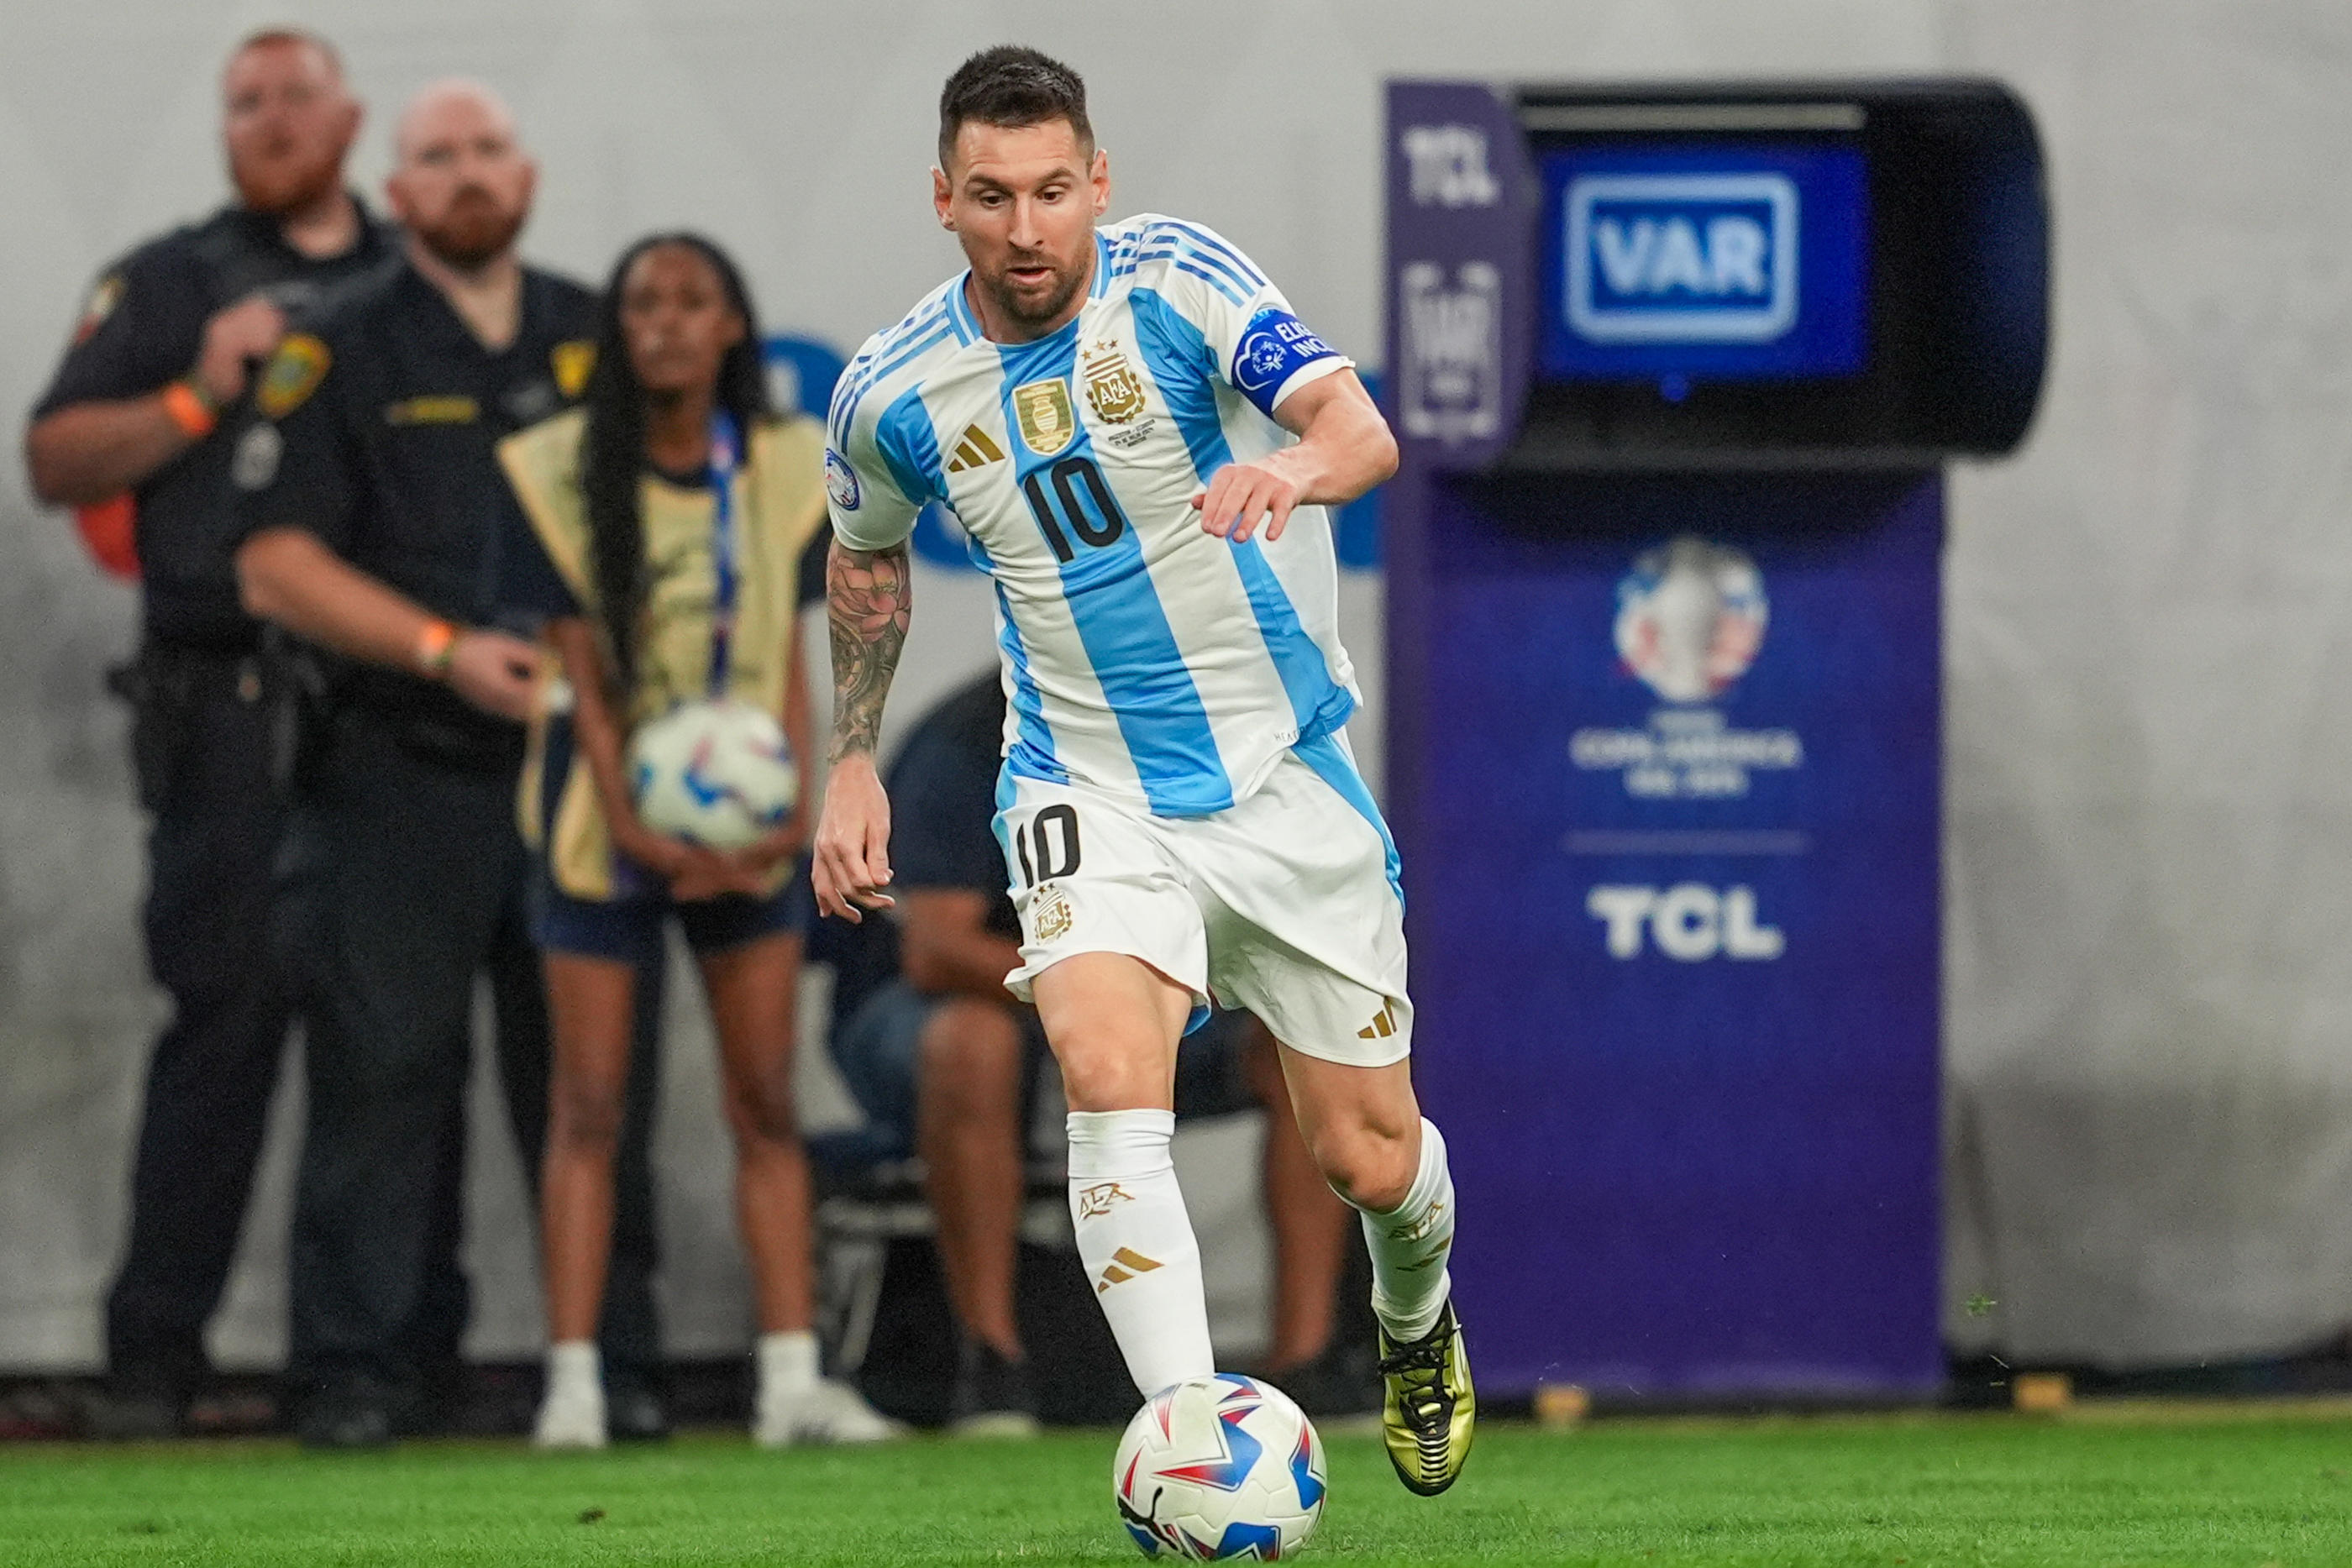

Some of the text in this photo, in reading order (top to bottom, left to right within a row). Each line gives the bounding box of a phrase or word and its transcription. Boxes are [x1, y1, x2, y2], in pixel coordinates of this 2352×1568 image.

[1598, 215, 1766, 294] VAR
[1097, 372, 1132, 406] AFA
[1025, 457, 1122, 564] 10
[1016, 804, 1080, 890] 10
[1586, 883, 1786, 962] TCL
